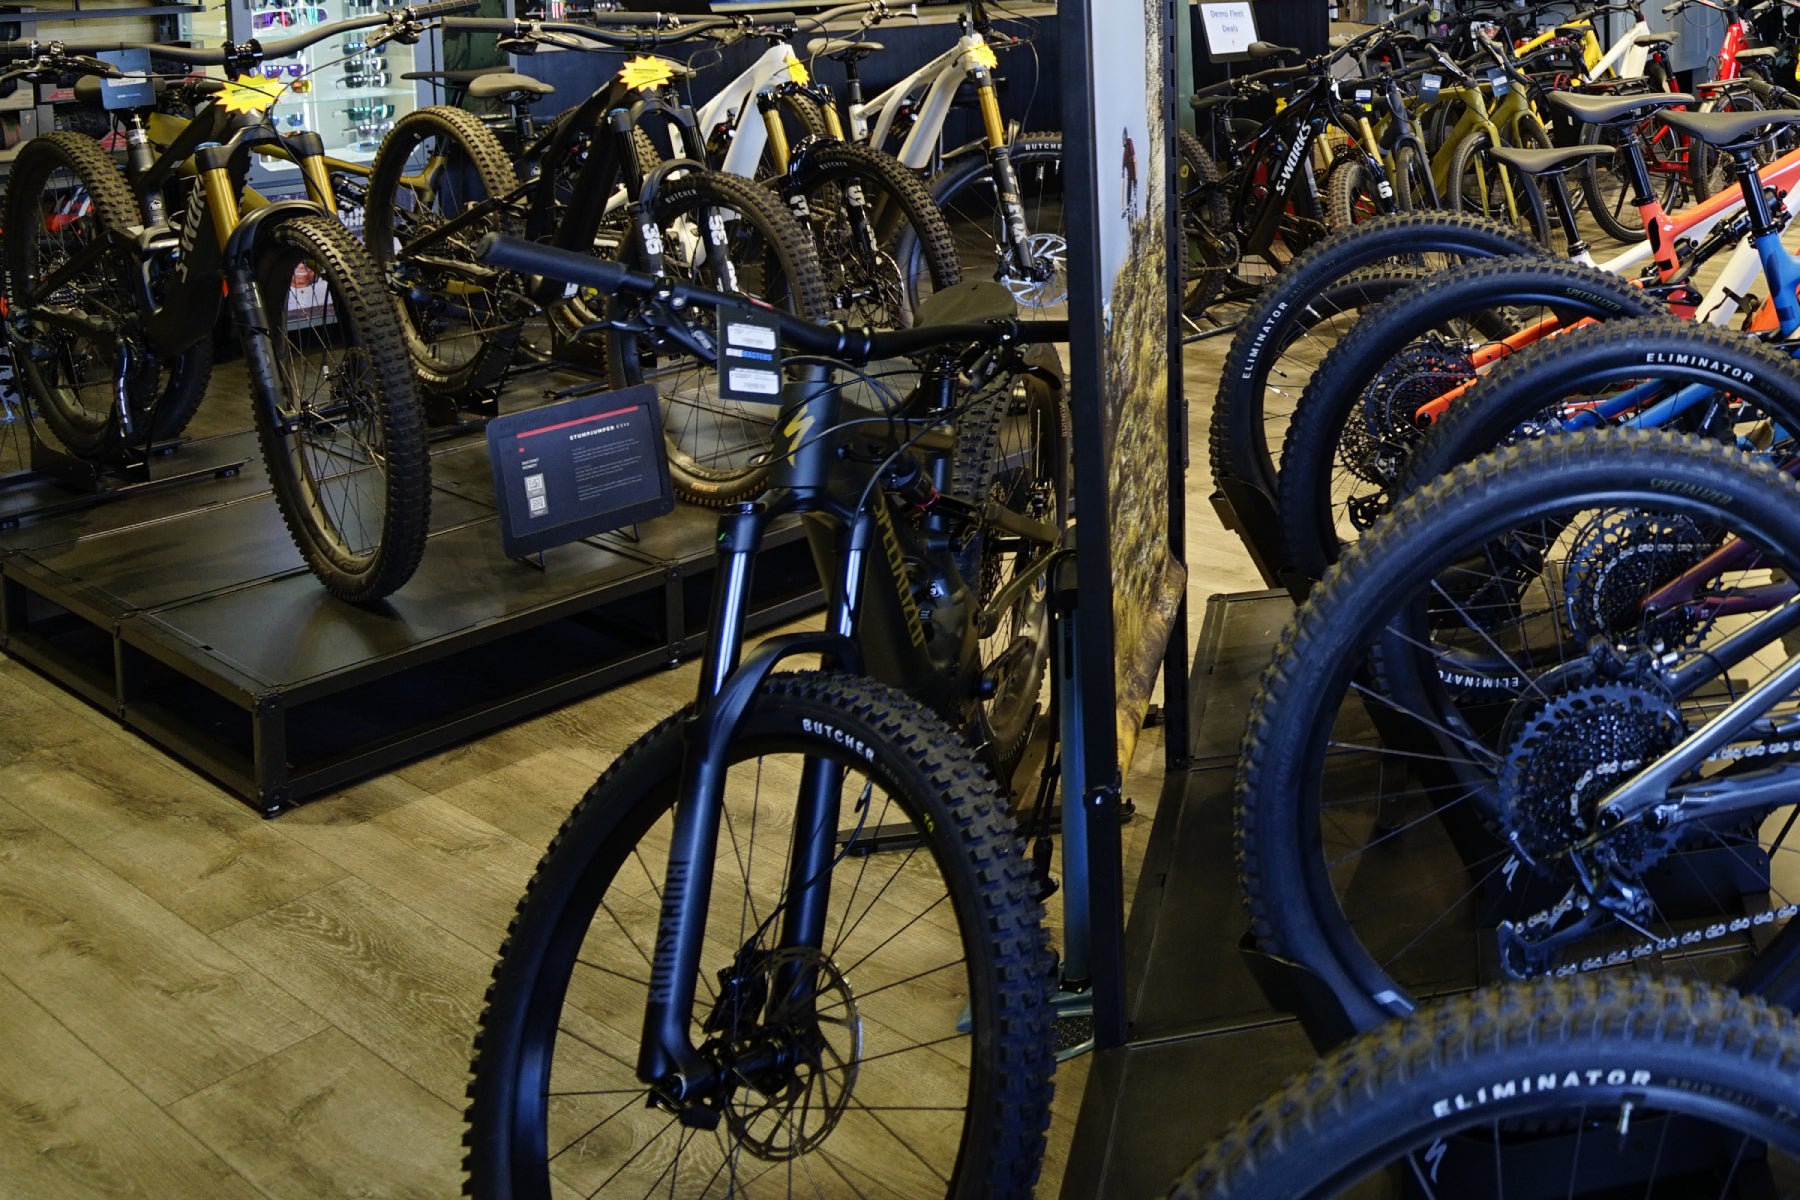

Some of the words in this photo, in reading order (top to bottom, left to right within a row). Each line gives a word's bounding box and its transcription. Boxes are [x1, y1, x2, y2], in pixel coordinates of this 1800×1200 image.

[1210, 10, 1228, 18] Demo
[1229, 10, 1244, 18] Fleet
[1222, 24, 1239, 32] Deals
[1025, 143, 1063, 152] BUTCHE
[1275, 120, 1312, 196] S-WORKS
[665, 189, 698, 205] BUTCHER
[1566, 286, 1622, 312] SPECIALIZED
[1241, 300, 1288, 380] ELIMINATOR
[1646, 353, 1754, 383] ELIMINATOR
[569, 425, 615, 441] STUMPJUMPER
[1650, 478, 1734, 505] SPECIALIZED
[802, 718, 875, 763] BUTCHER
[1432, 1069, 1652, 1118] ELIMINATOR
